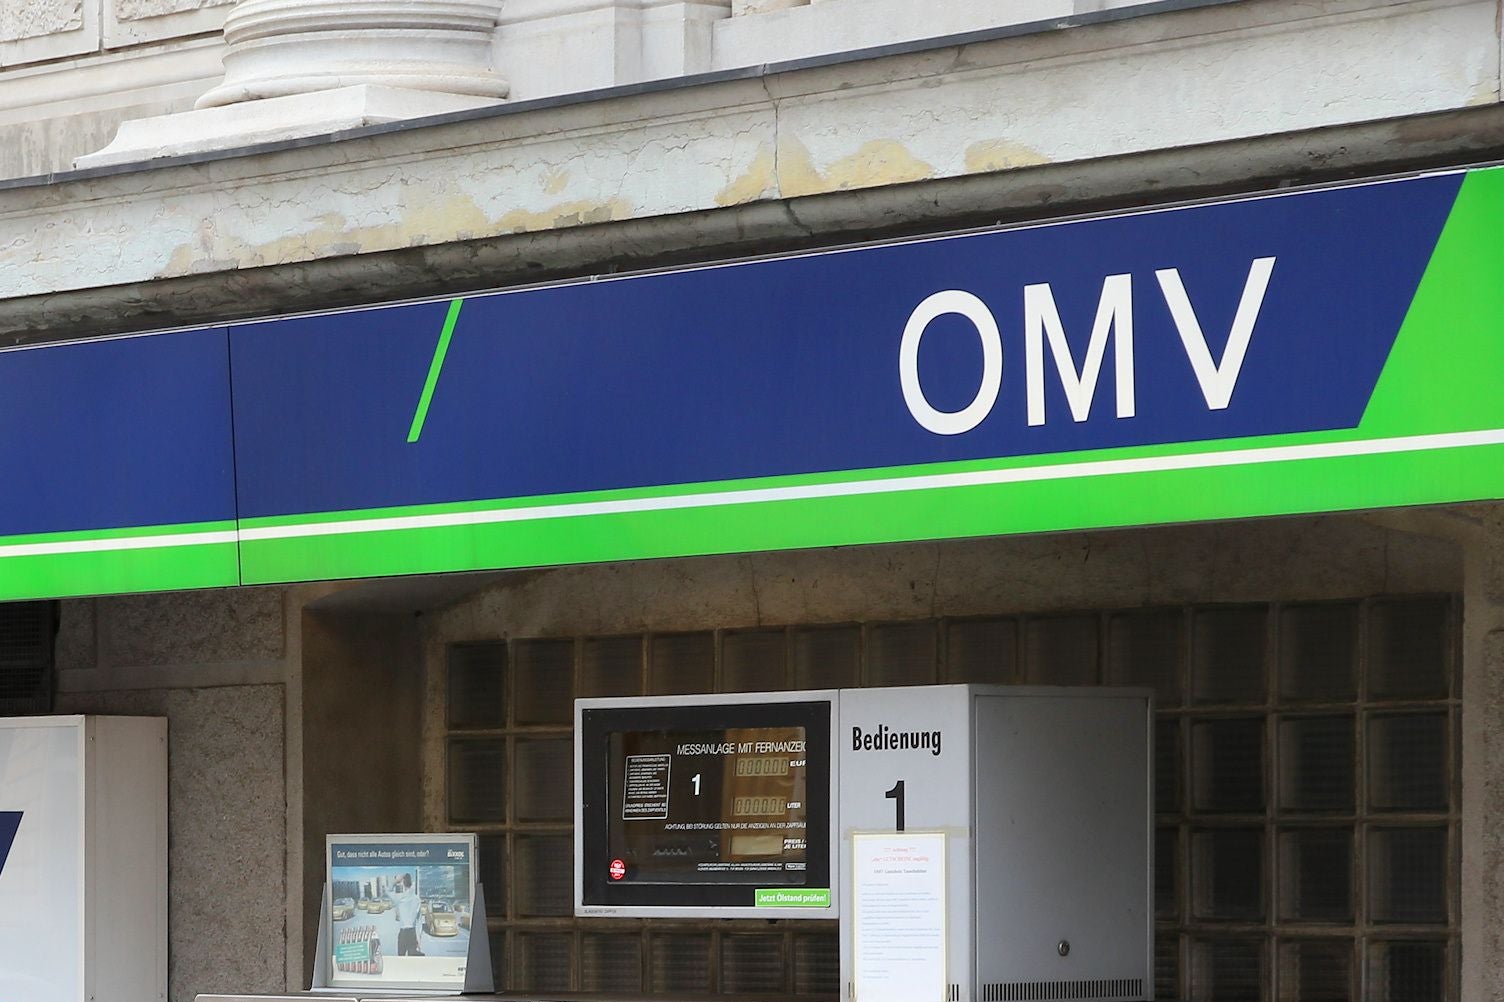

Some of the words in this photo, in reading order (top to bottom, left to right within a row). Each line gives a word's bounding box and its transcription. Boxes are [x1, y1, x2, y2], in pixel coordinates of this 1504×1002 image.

[899, 256, 1277, 436] OMV
[676, 743, 736, 756] MESSANLAGE
[738, 742, 754, 754] MIT
[852, 724, 941, 756] Bedienung
[691, 774, 701, 796] 1
[885, 780, 904, 832] 1
[776, 893, 802, 902] Ölstand
